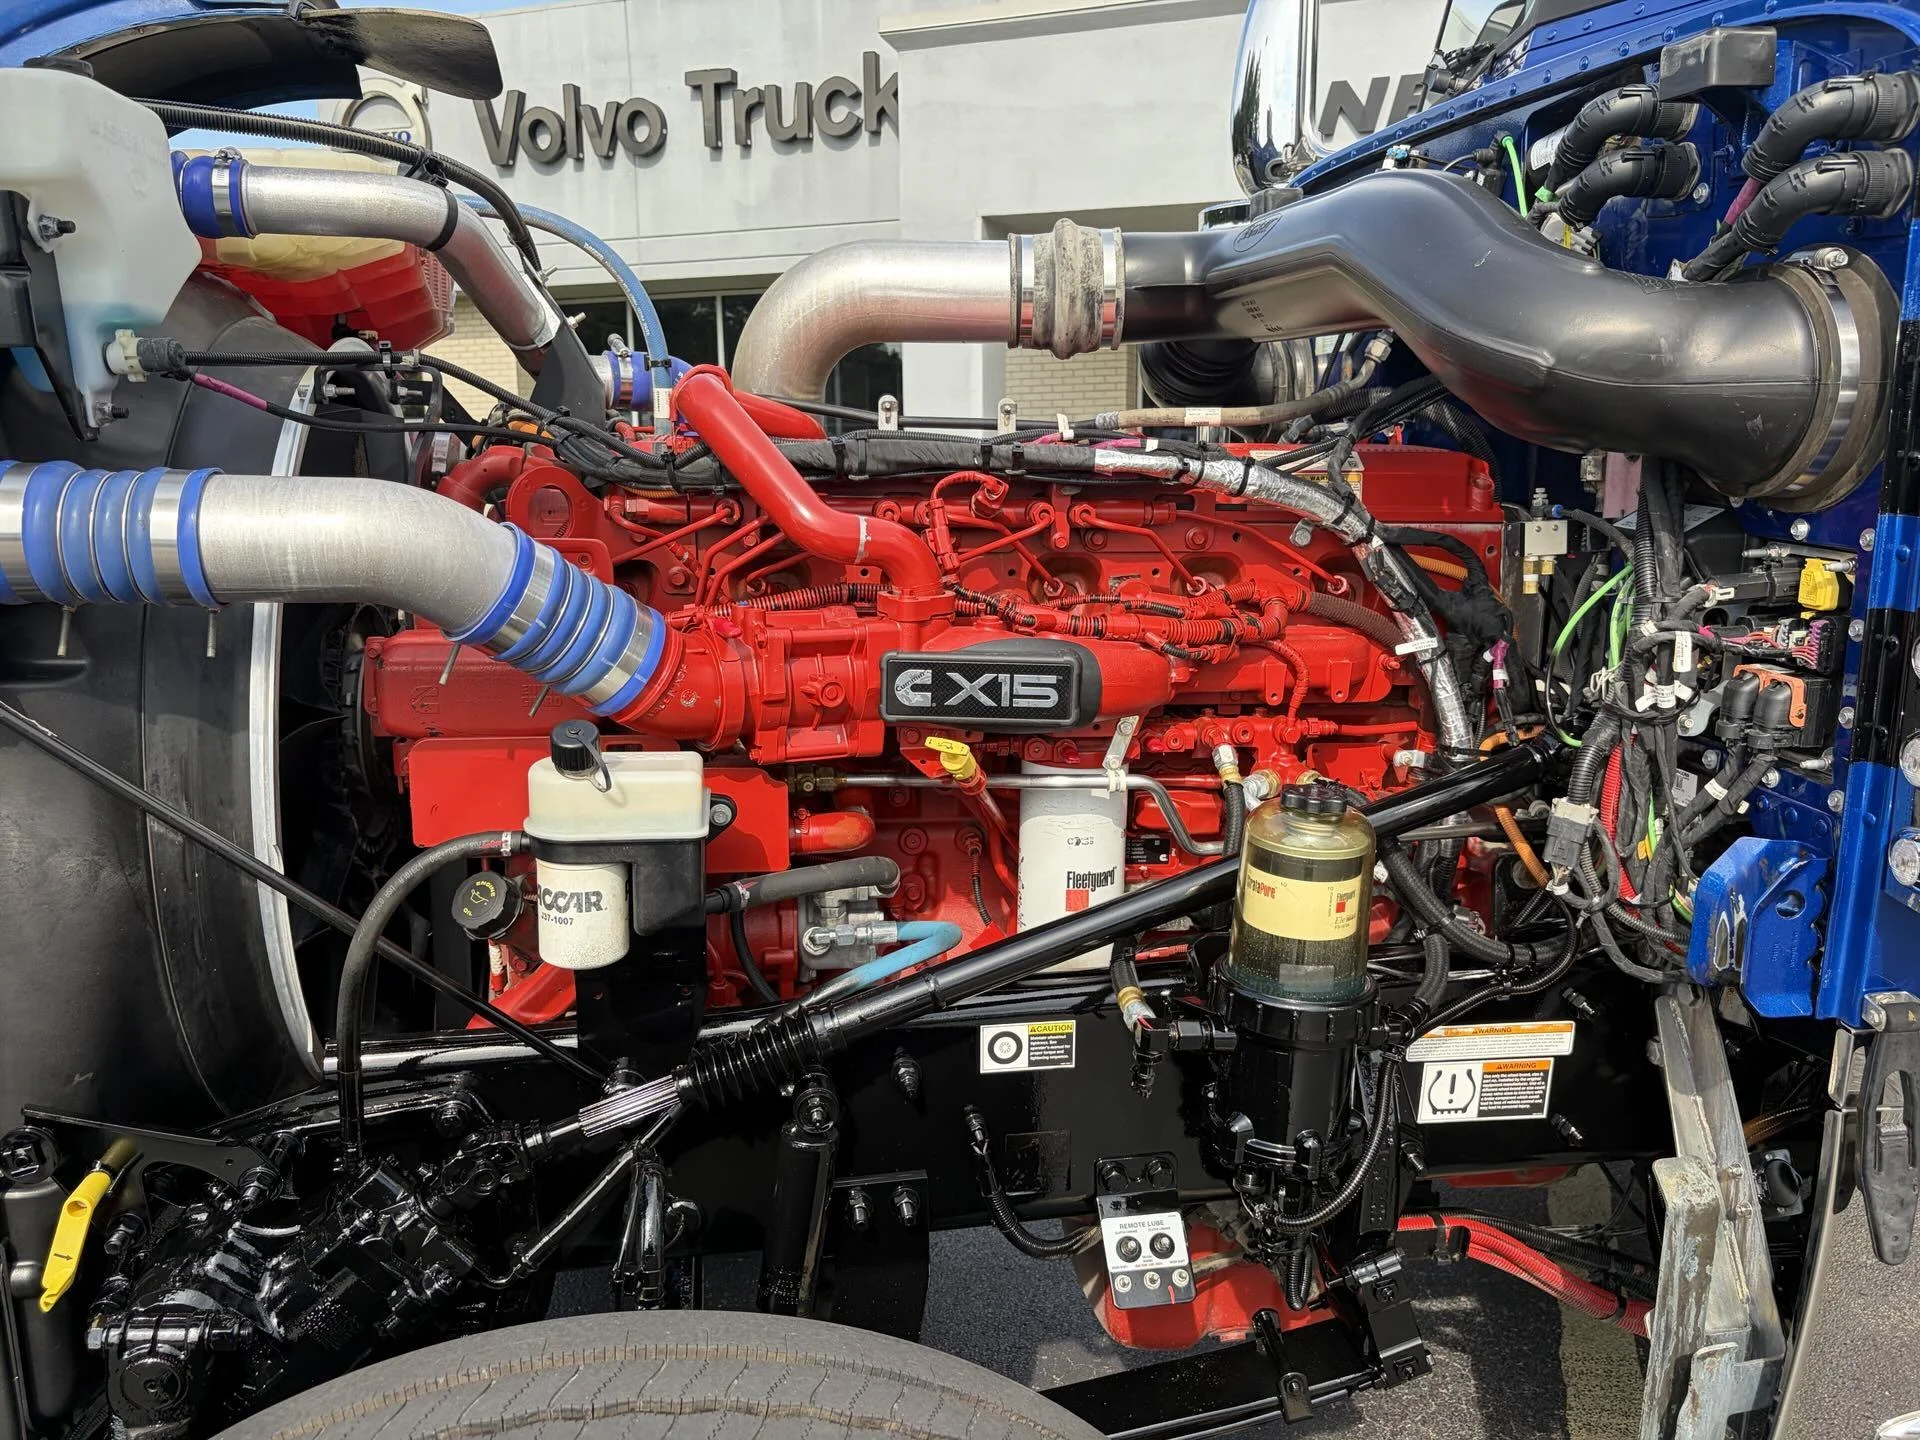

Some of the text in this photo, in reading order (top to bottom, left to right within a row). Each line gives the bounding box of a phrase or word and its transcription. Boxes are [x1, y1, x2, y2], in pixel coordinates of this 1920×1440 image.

[473, 51, 899, 167] Volvo Truck
[944, 672, 1059, 709] X15
[1066, 867, 1116, 892] Fleetguard
[475, 880, 496, 897] ENGINE
[538, 884, 604, 914] CCAR
[1036, 1024, 1073, 1033] CAUTION
[1478, 1026, 1512, 1034] WARNING
[1503, 1062, 1537, 1070] WARNING
[1119, 1219, 1164, 1230] REMOTE LUBE
